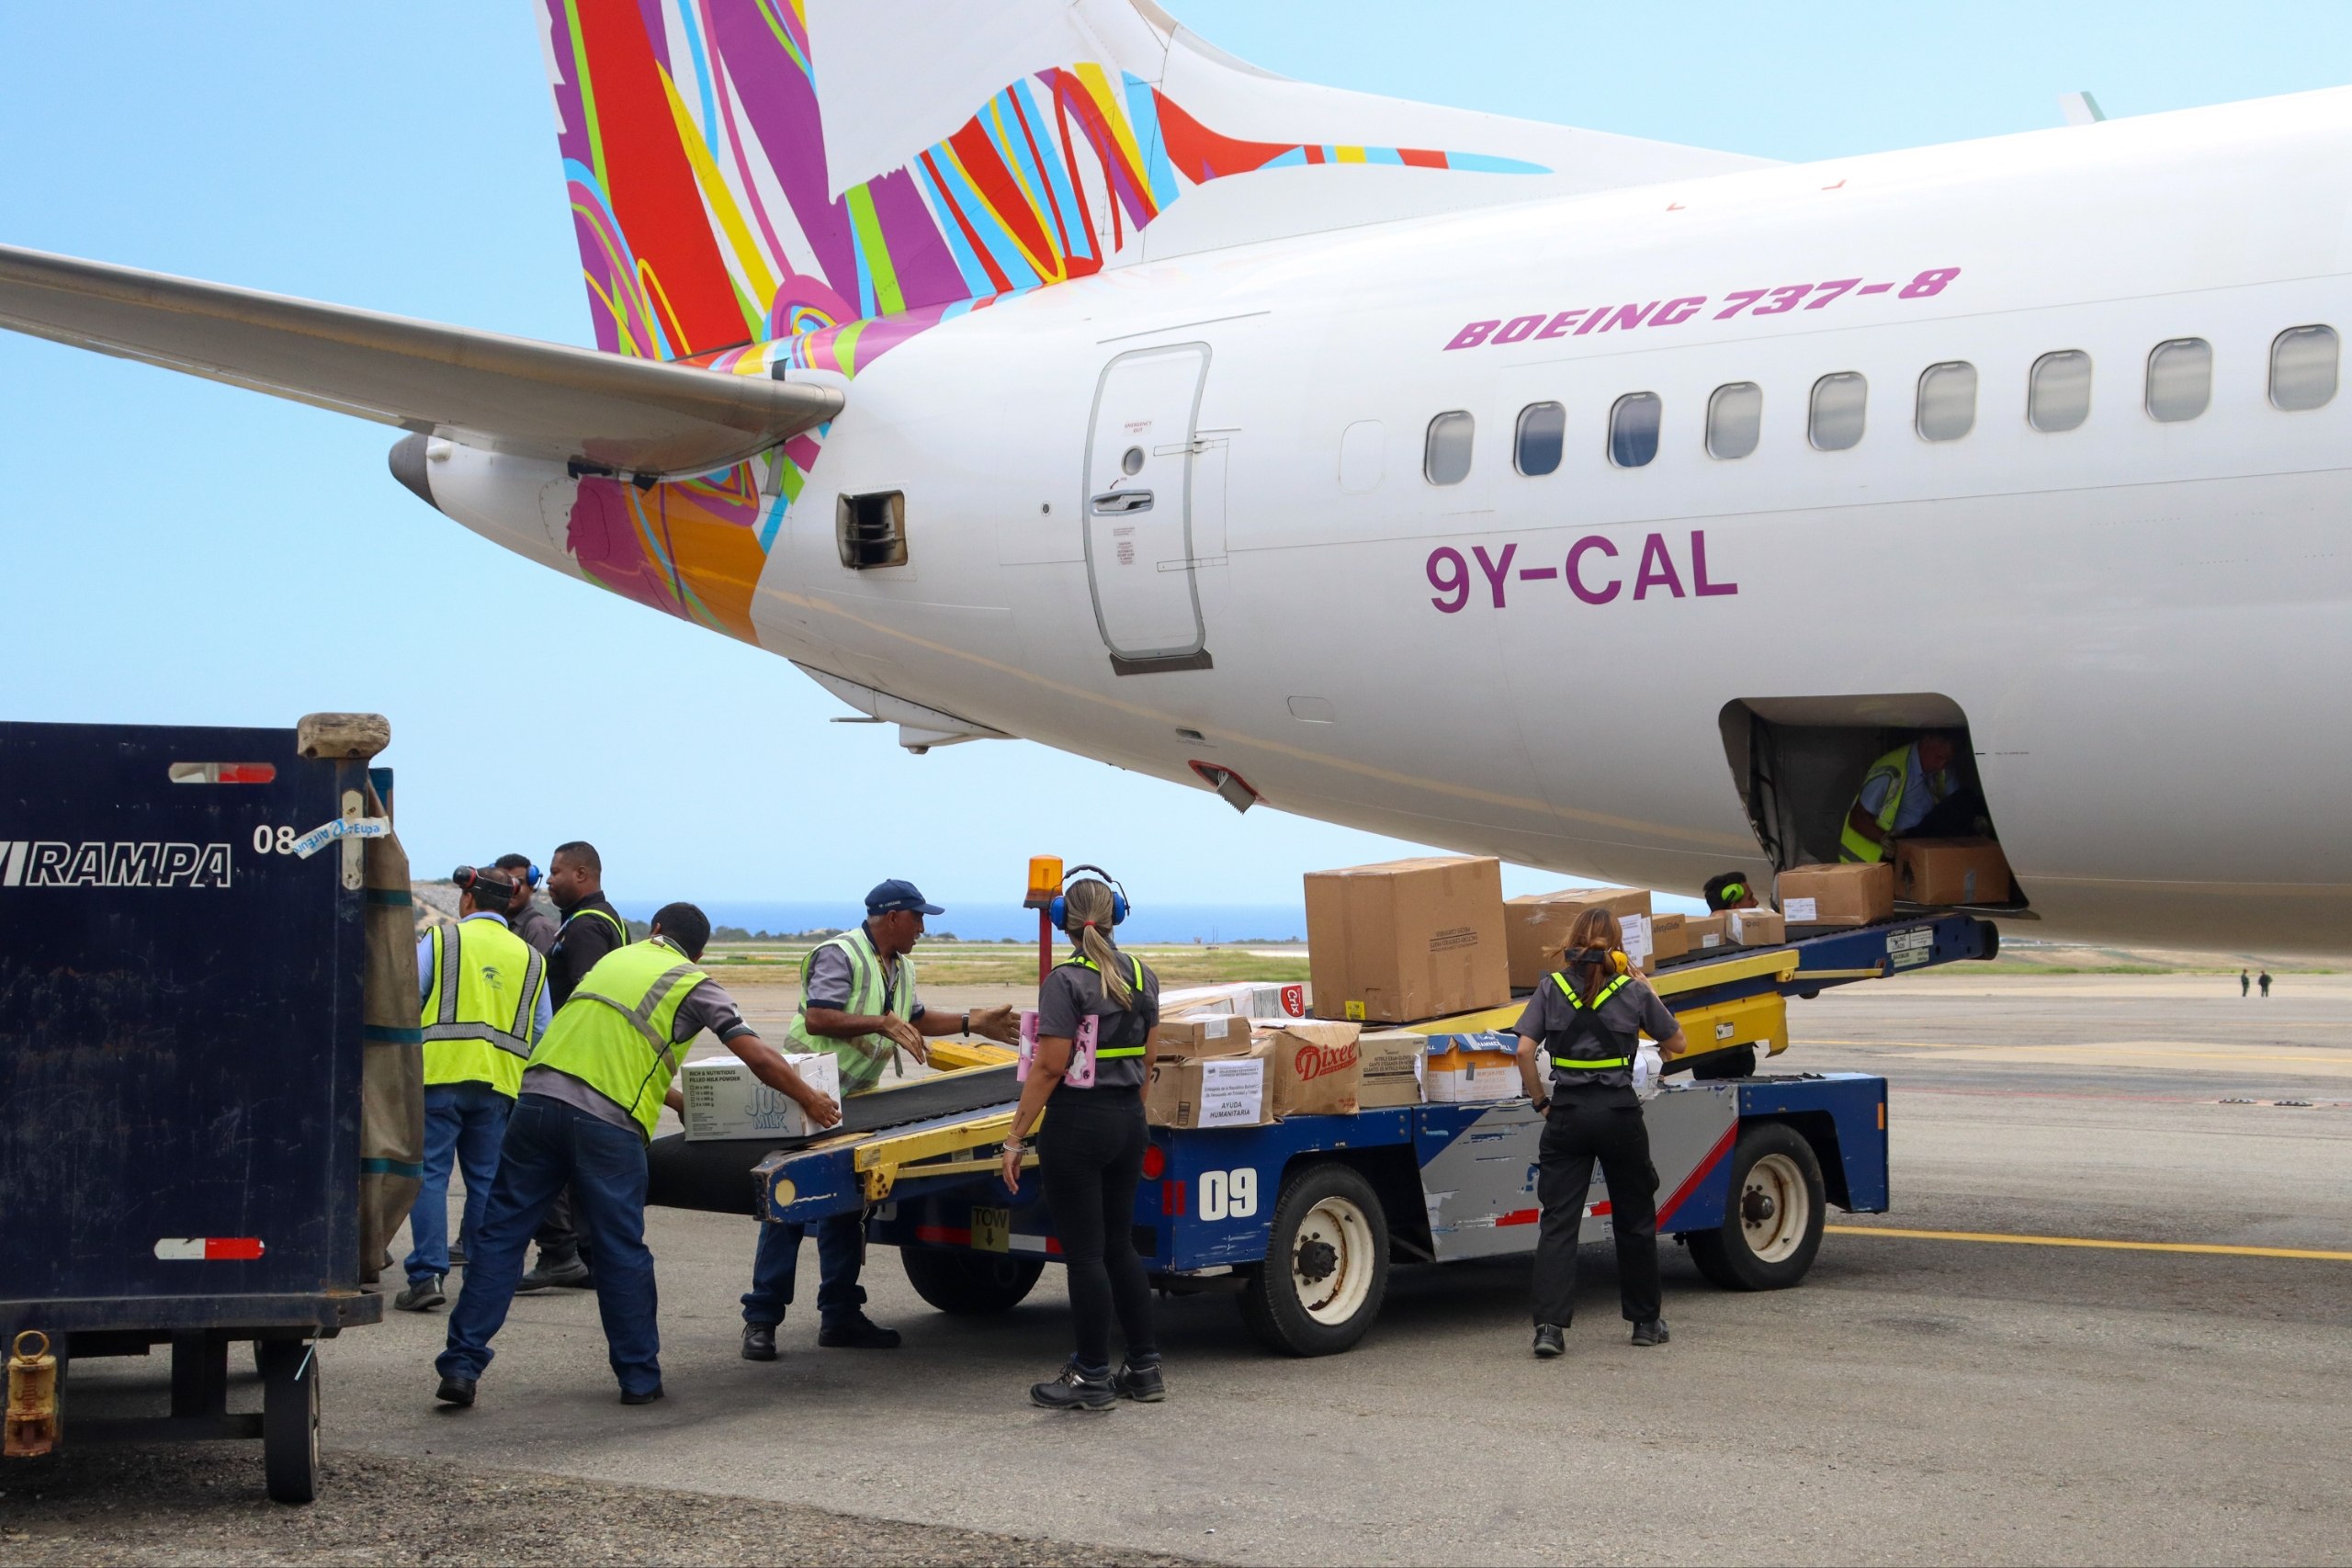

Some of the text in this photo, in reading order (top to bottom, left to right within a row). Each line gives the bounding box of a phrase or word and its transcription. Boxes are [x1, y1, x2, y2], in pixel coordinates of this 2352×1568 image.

[1442, 266, 1962, 351] BOEING 737-8
[1426, 530, 1738, 614] 9Y-CAL
[253, 825, 296, 854] 08
[1654, 921, 1680, 933] afetyGlide
[1287, 989, 1300, 1014] Crix
[1295, 1041, 1357, 1081] Dixee
[1210, 1109, 1250, 1118] HUMANITARIA
[1221, 1101, 1242, 1110] AYUDA
[752, 1114, 785, 1130] MILK
[1198, 1168, 1258, 1221] 09
[973, 1208, 1008, 1228] TOW
